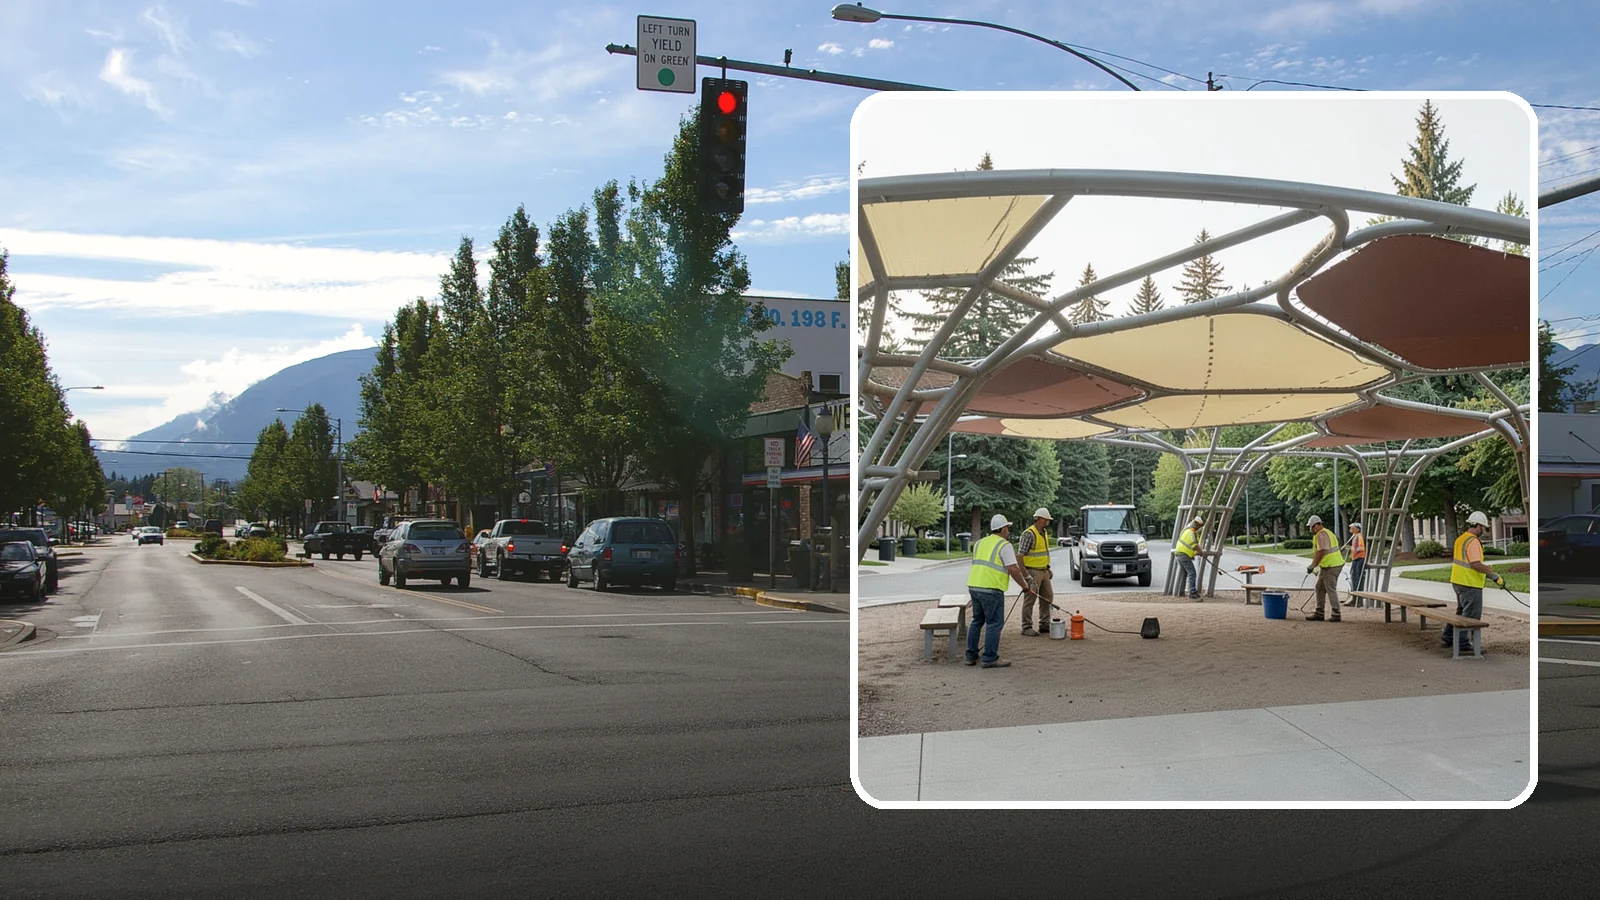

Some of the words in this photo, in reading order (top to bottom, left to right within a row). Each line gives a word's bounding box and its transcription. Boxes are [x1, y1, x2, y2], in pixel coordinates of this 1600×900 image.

[643, 23, 663, 34] LEFT
[668, 26, 690, 36] TURN
[652, 37, 682, 52] YIELD
[644, 53, 656, 63] ON
[661, 54, 689, 66] GREEN
[791, 309, 826, 328] 198
[831, 311, 846, 329] F.
